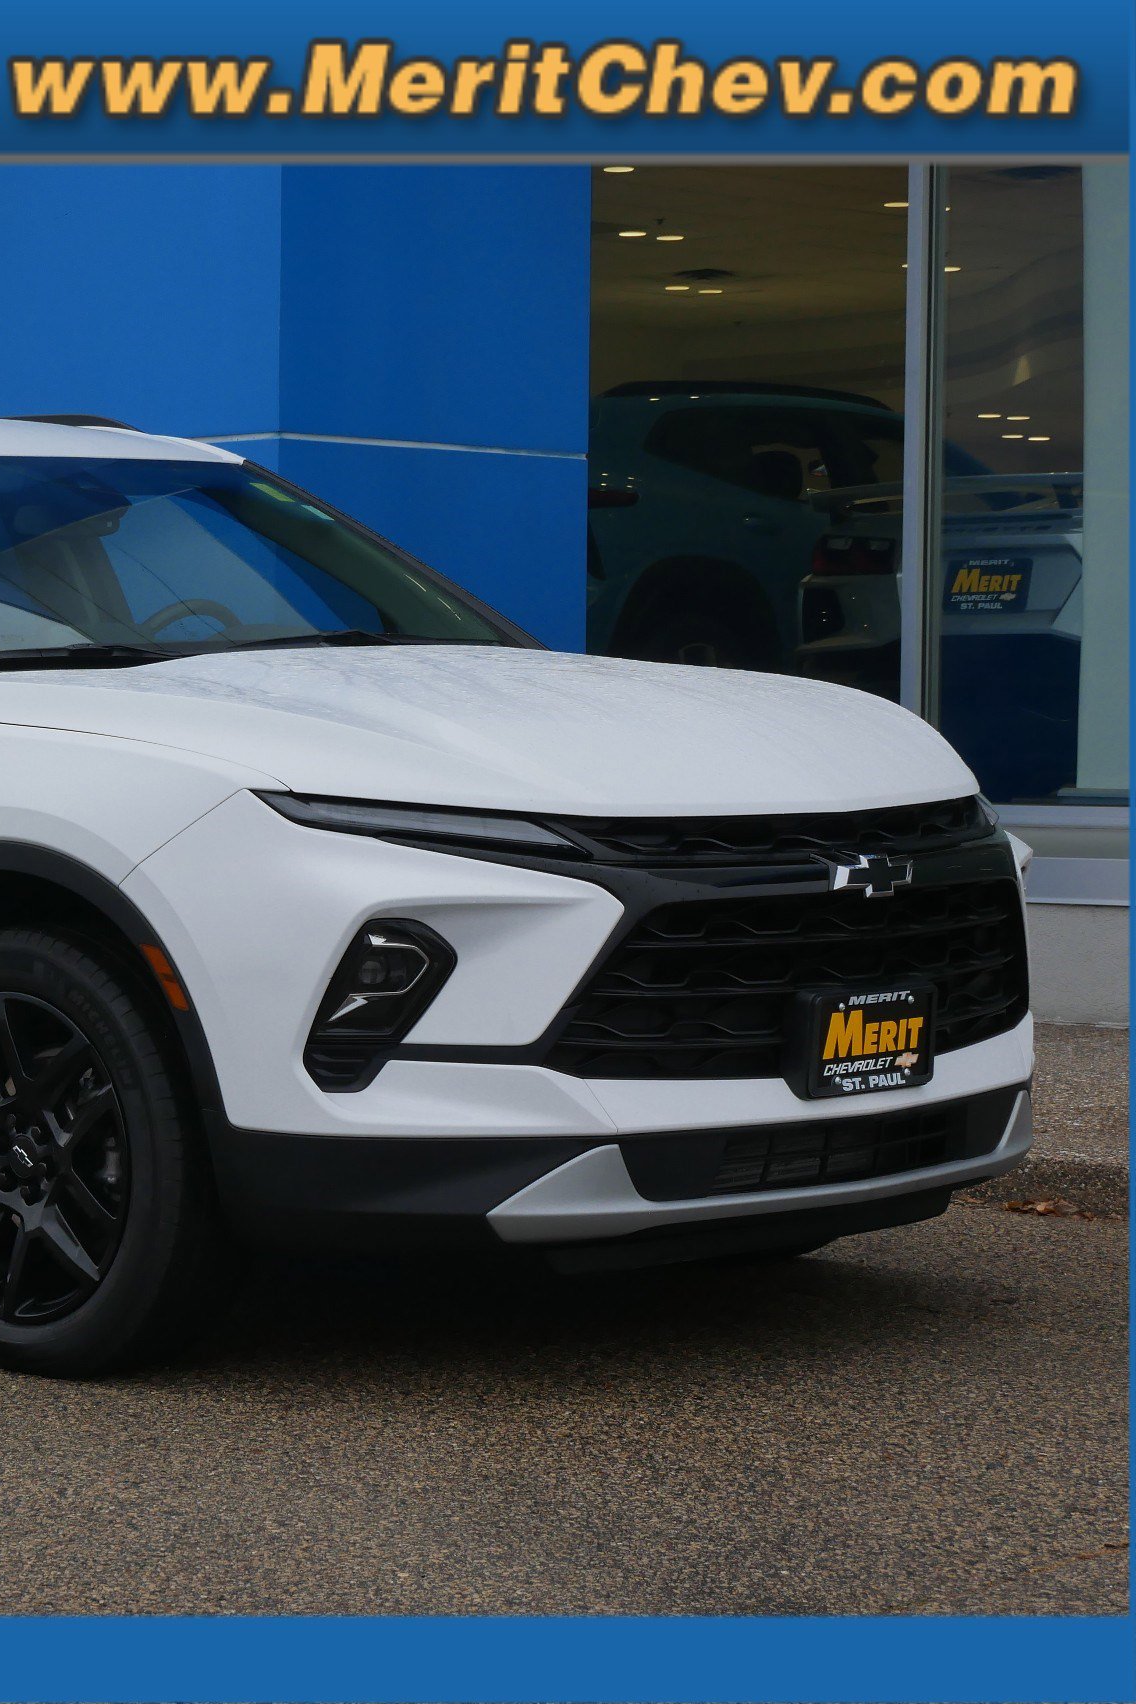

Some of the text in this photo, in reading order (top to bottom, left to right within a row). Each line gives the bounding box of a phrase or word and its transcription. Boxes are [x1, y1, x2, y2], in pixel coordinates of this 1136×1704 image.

[951, 568, 1023, 593] MERIT
[977, 602, 1003, 610] PAUL
[848, 990, 911, 1006] MERIT
[822, 1009, 924, 1060] MERIT
[823, 1056, 894, 1077] CHEVROLET
[841, 1072, 906, 1092] ST. PAUL
